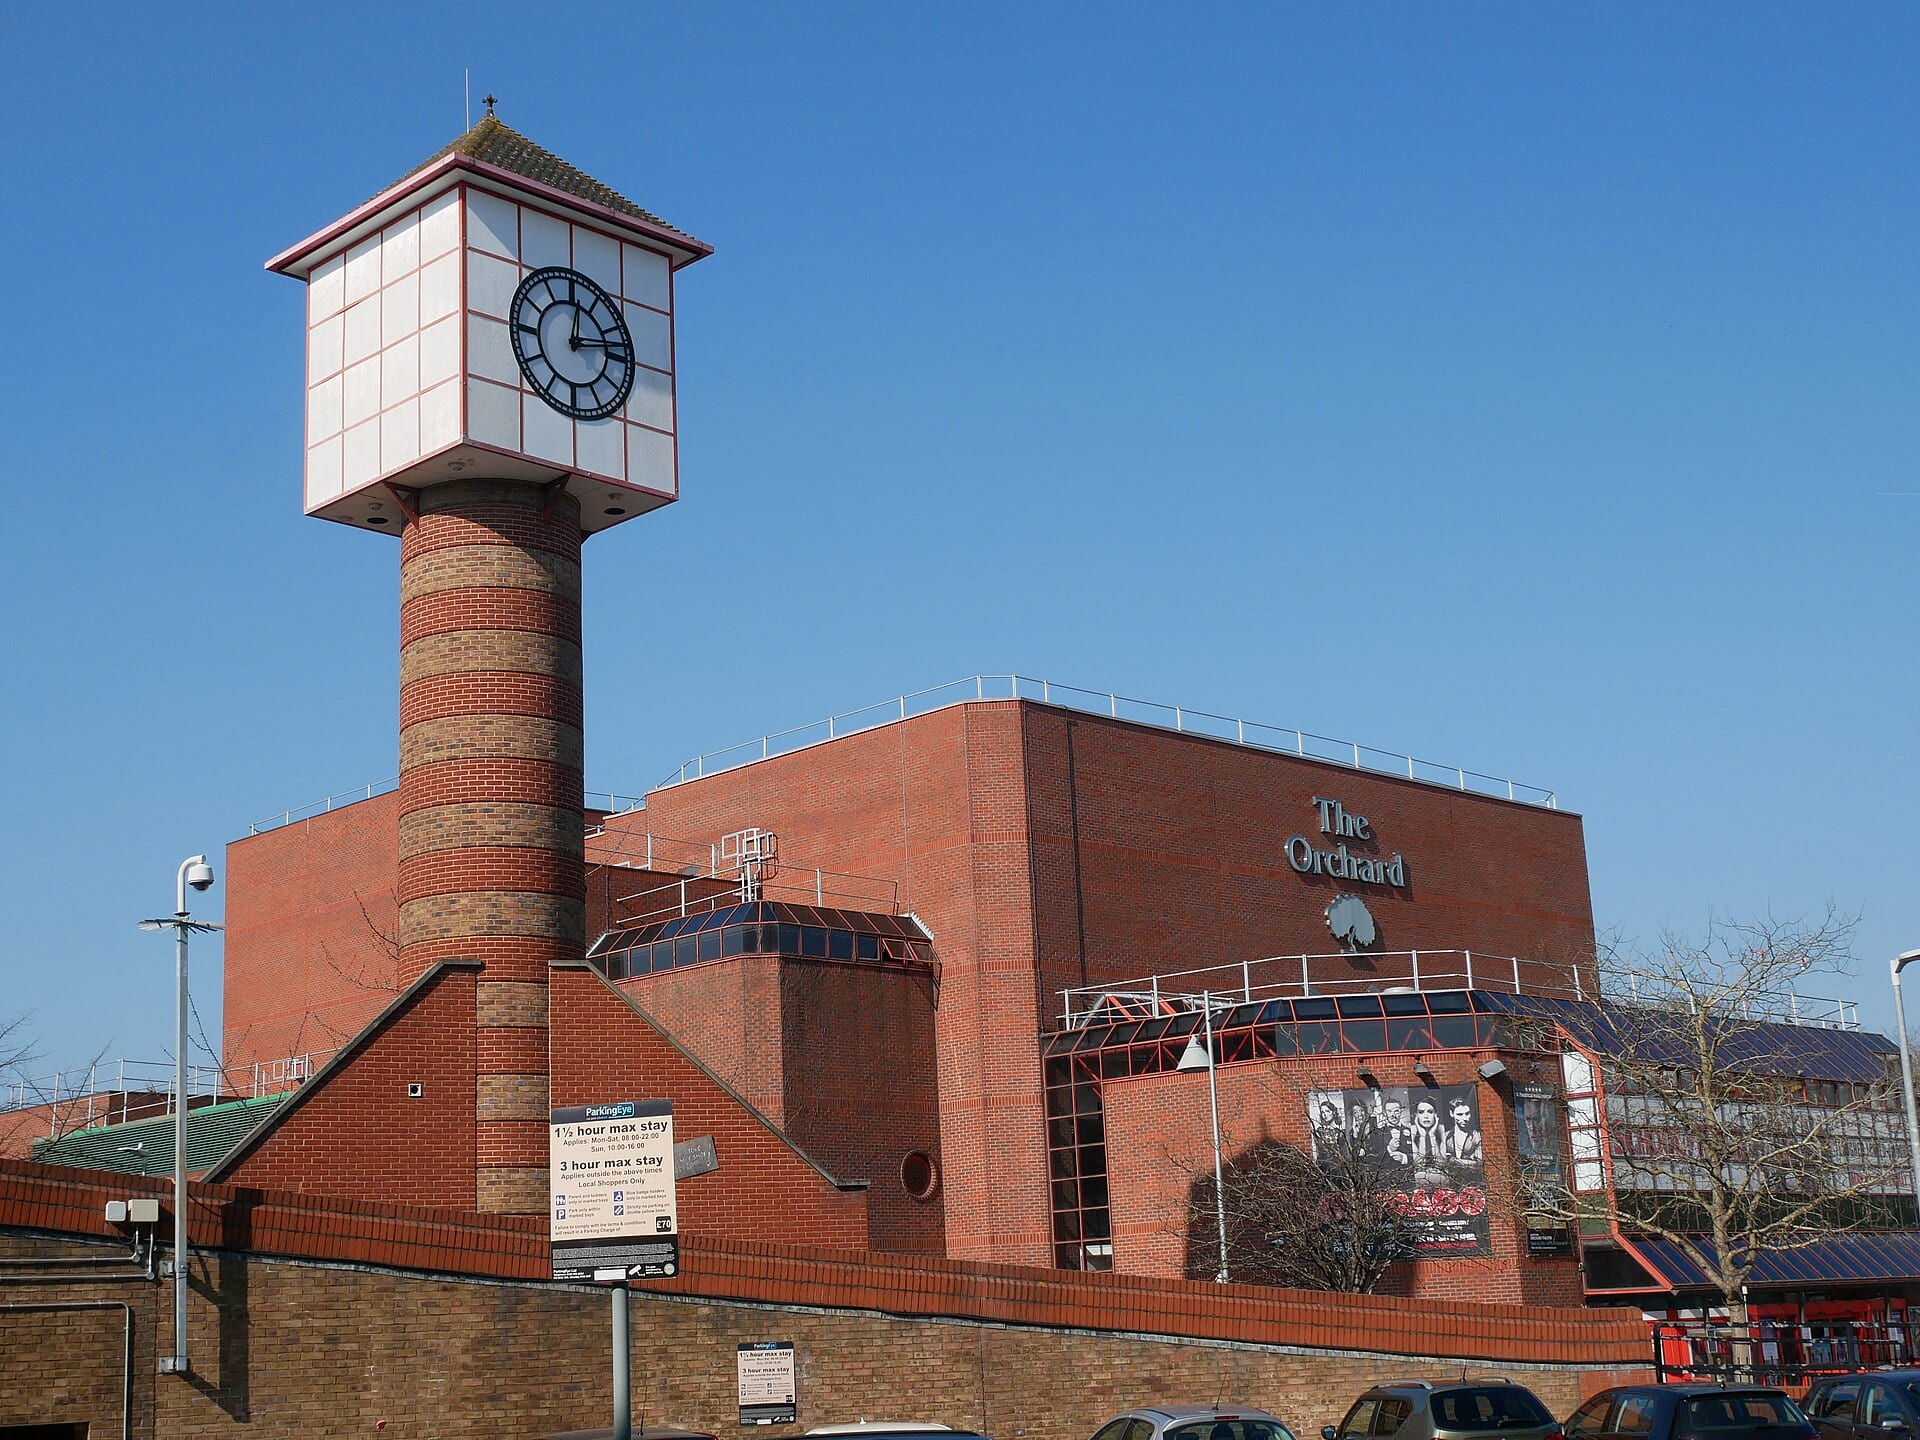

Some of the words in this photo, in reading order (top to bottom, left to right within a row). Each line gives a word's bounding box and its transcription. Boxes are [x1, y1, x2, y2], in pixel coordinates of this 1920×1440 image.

[1312, 796, 1370, 840] The
[1284, 834, 1405, 887] Orchard
[586, 1104, 632, 1117] ParkingEye
[577, 1126, 606, 1137] hour
[609, 1123, 636, 1134] max
[640, 1120, 668, 1132] stay
[560, 1161, 568, 1171] 3
[572, 1161, 600, 1170] hour
[604, 1158, 632, 1168] max
[636, 1155, 663, 1167] stay
[561, 1173, 585, 1181] Applies
[587, 1170, 610, 1178] outside
[597, 1178, 629, 1187] Shoppers
[630, 1177, 646, 1185] Only
[656, 1220, 671, 1229] £70
